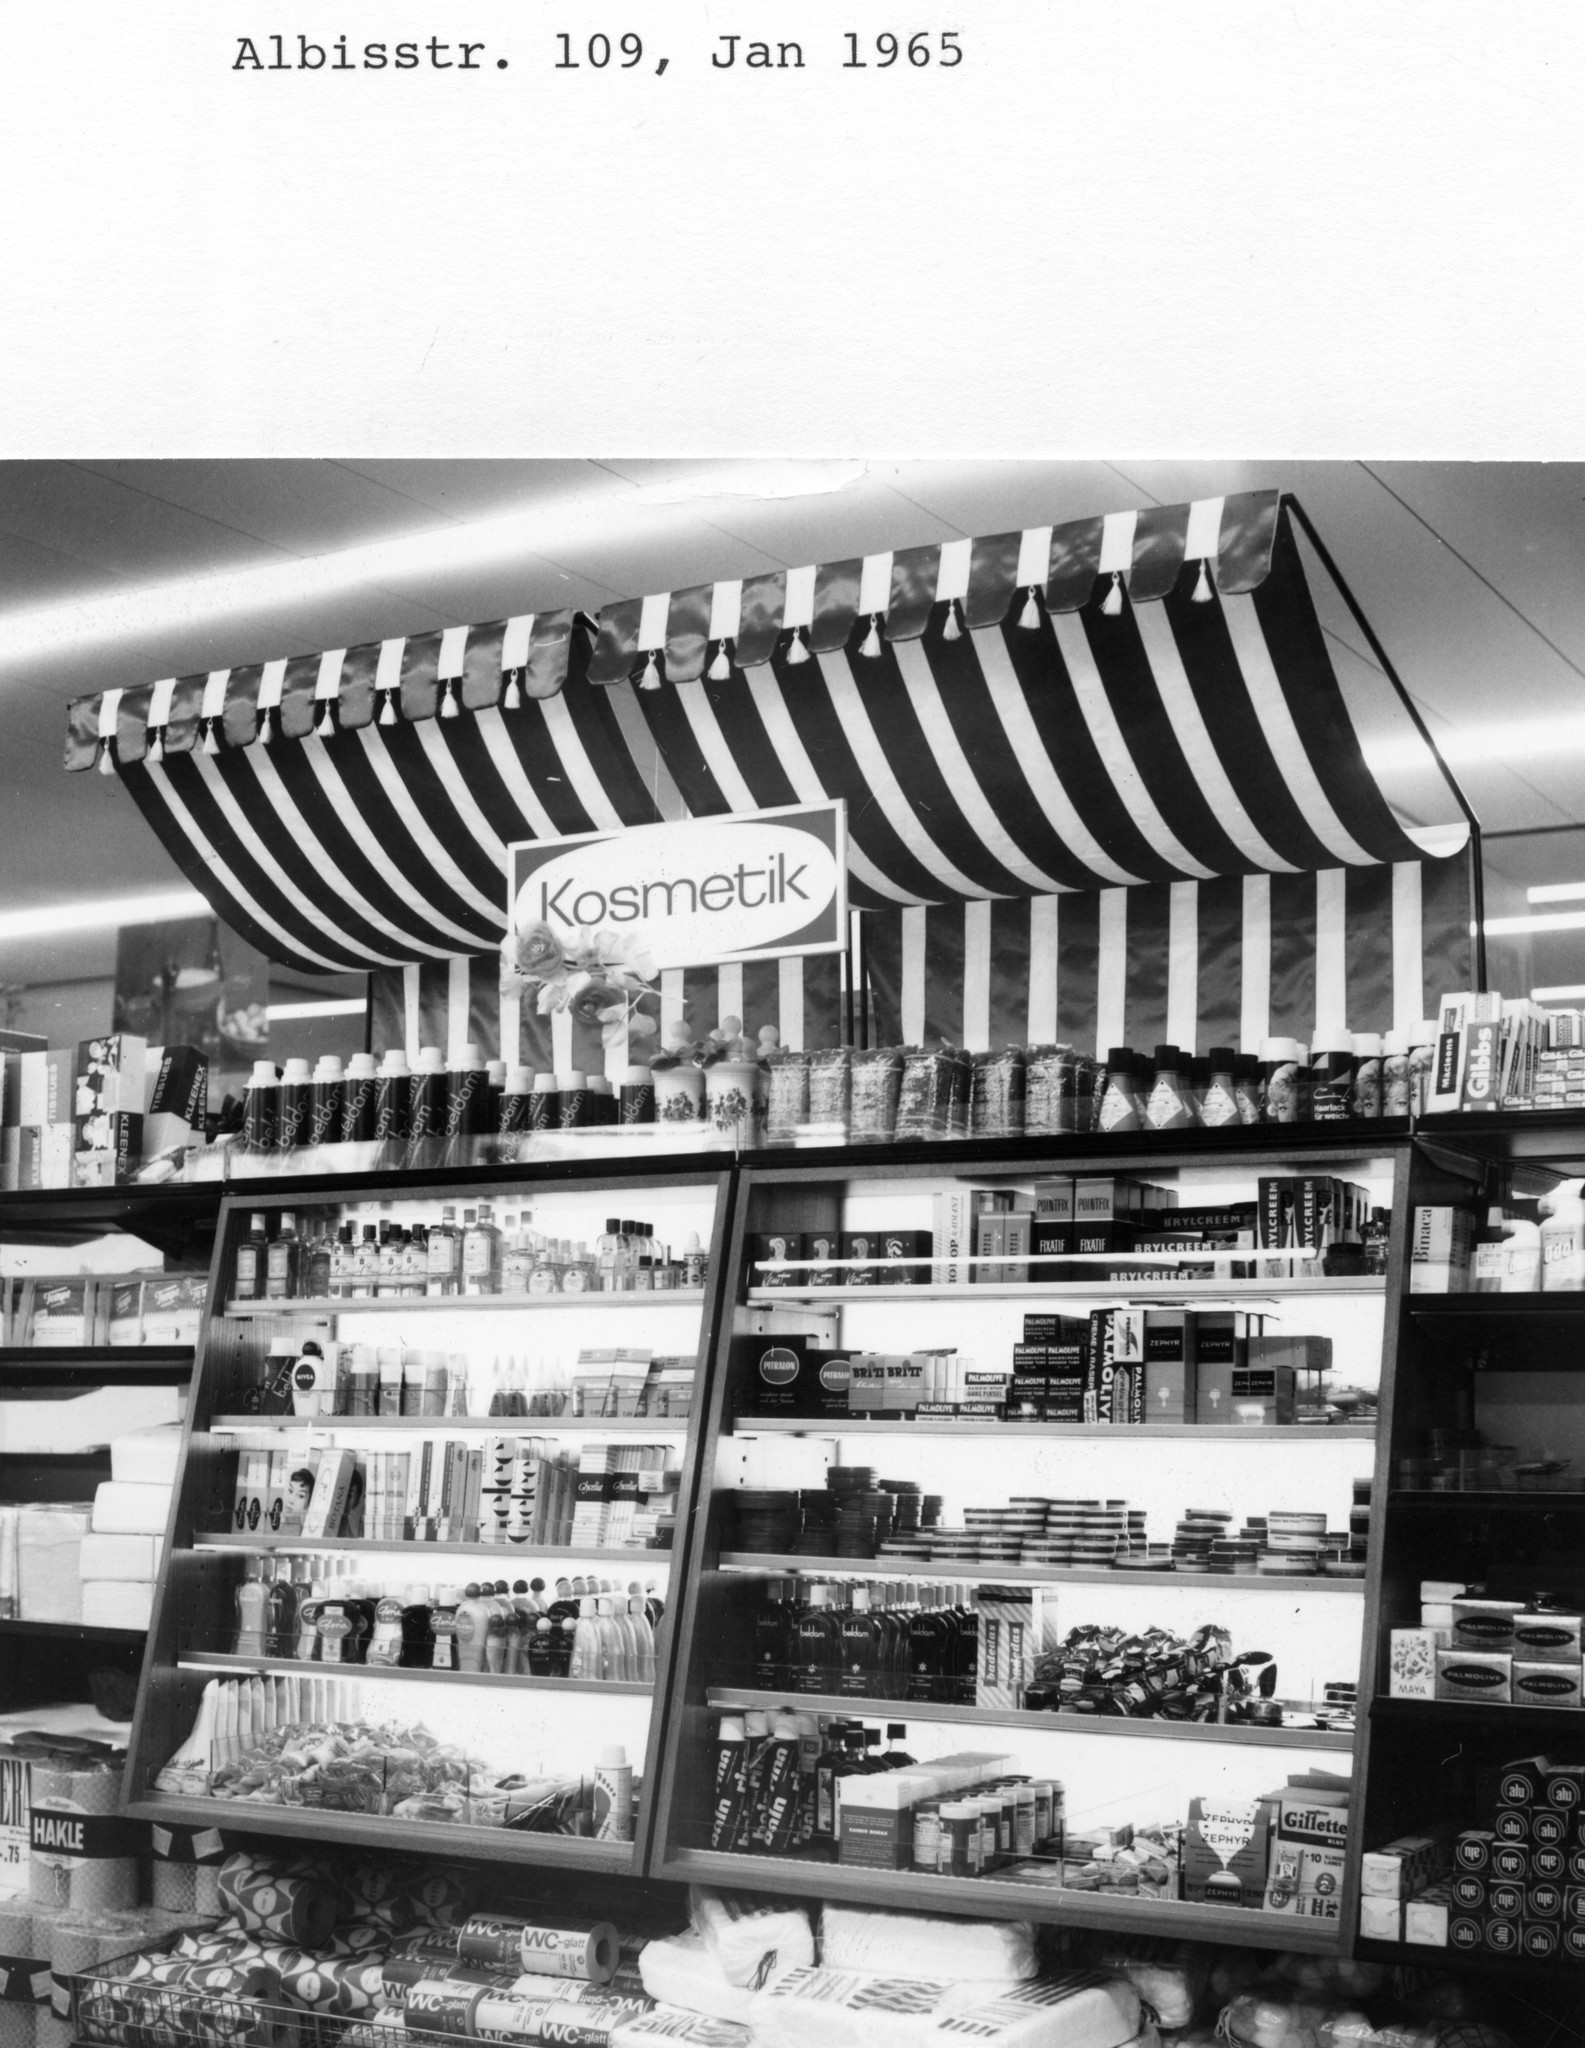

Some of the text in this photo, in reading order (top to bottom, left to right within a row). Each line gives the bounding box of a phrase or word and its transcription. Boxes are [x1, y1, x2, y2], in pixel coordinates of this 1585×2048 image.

[541, 852, 811, 927] Kosmetik
[1467, 1027, 1492, 1099] Gibbs
[152, 1057, 172, 1110] TISSUES
[184, 1065, 206, 1121] KLEENEX
[118, 1114, 130, 1174] KLEENEX
[1037, 1198, 1069, 1212] POINTFIX
[1078, 1197, 1110, 1211] POINTFIX
[1164, 1215, 1241, 1228] BRYLCREEM
[1269, 1182, 1279, 1249] RYLCREEM
[1304, 1181, 1313, 1249] RYLCREEM
[1413, 1209, 1432, 1263] Binaca
[1039, 1239, 1066, 1253] FIXATIF
[1080, 1238, 1106, 1252] FIXATIF
[1134, 1242, 1212, 1253] BRYLCREEM
[1110, 1271, 1188, 1281] BRYLCREEM
[1025, 1318, 1056, 1326] PALMOLIVE
[1091, 1313, 1099, 1347] CREME
[1150, 1339, 1180, 1347] ZEPHYR
[763, 1361, 796, 1370] PITRALON
[1100, 1314, 1115, 1424] PALMOLIVE
[968, 1374, 1004, 1382] PALMOLIVE
[1088, 1356, 1097, 1390] RASER
[1050, 1378, 1082, 1386] PALMOLIVE
[919, 1404, 953, 1413] PALMOLIVE
[960, 1404, 995, 1413] PALMOLIVE
[329, 1485, 346, 1531] BOTANA
[378, 1605, 401, 1616] Gloria
[319, 1619, 349, 1630] Gloria
[801, 1625, 825, 1638] beldam
[842, 1624, 869, 1638] beldam
[910, 1624, 936, 1637] beldam
[1460, 1623, 1514, 1632] PALMOLIVE
[1520, 1633, 1570, 1641] PALMOLIVE
[986, 1625, 996, 1680] badedas
[1447, 1672, 1501, 1682] PALMOLIVE
[1400, 1684, 1426, 1695] MAYA
[1522, 1681, 1572, 1689] PALMOLIVE
[1509, 1783, 1525, 1798] alu
[1556, 1787, 1572, 1801] alu
[1285, 1810, 1348, 1835] Gillette
[1504, 1821, 1520, 1835] alu
[34, 1816, 84, 1850] HAKLE
[1541, 1823, 1557, 1838] alu
[1202, 1833, 1250, 1846] ZEPHYR
[1328, 1838, 1345, 1846] BLUE
[1464, 1846, 1480, 1860] alu
[1502, 1857, 1517, 1871] alu
[1541, 1855, 1557, 1869] alu
[1461, 1884, 1476, 1898] alu
[1498, 1893, 1514, 1908] alu
[1537, 1892, 1553, 1907] alu
[524, 1930, 586, 1949] WC-glatt
[1458, 1927, 1473, 1941] alu
[1494, 1927, 1509, 1943] alu
[1532, 1936, 1548, 1950] alu
[408, 1992, 468, 2012] WC-glatt
[542, 2021, 608, 2045] WC-glatt
